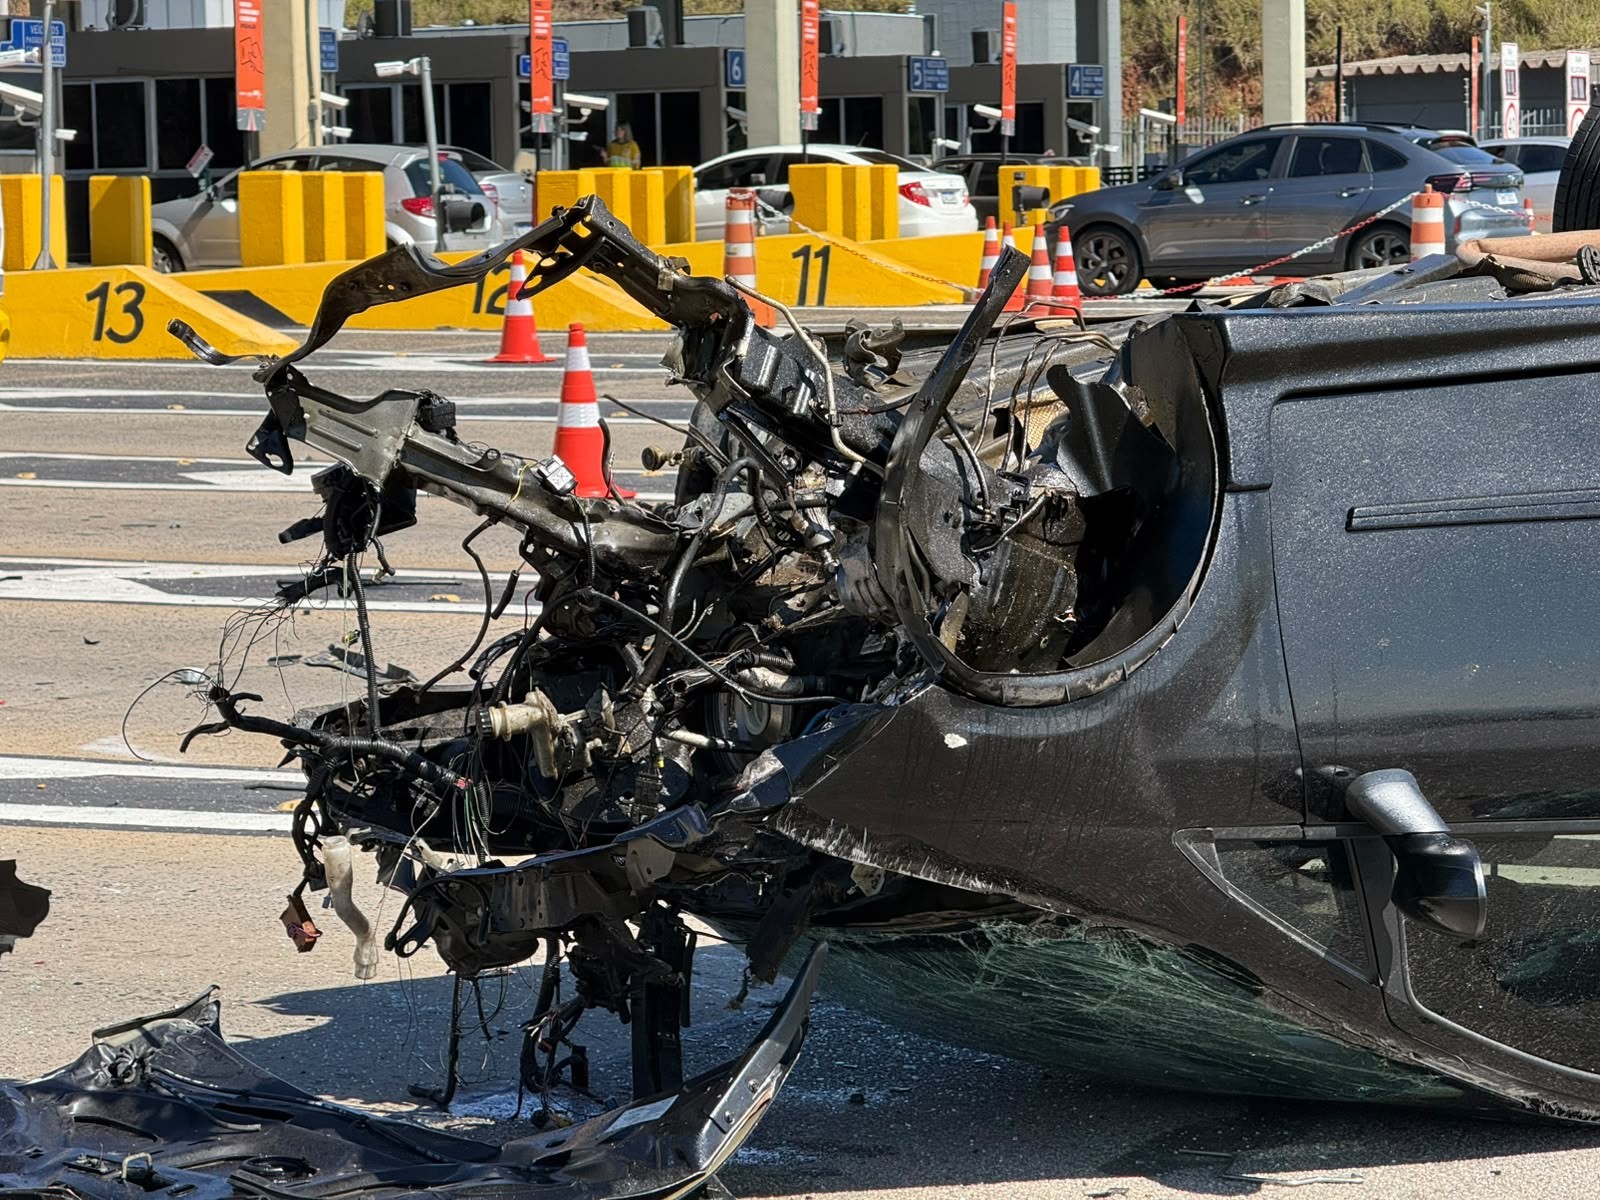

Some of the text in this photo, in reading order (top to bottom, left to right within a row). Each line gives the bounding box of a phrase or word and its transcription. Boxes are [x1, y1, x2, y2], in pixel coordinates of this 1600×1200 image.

[732, 56, 742, 80] 6
[913, 62, 922, 86] 5
[1071, 70, 1080, 92] 4
[792, 245, 831, 306] 11
[85, 281, 146, 344] 13
